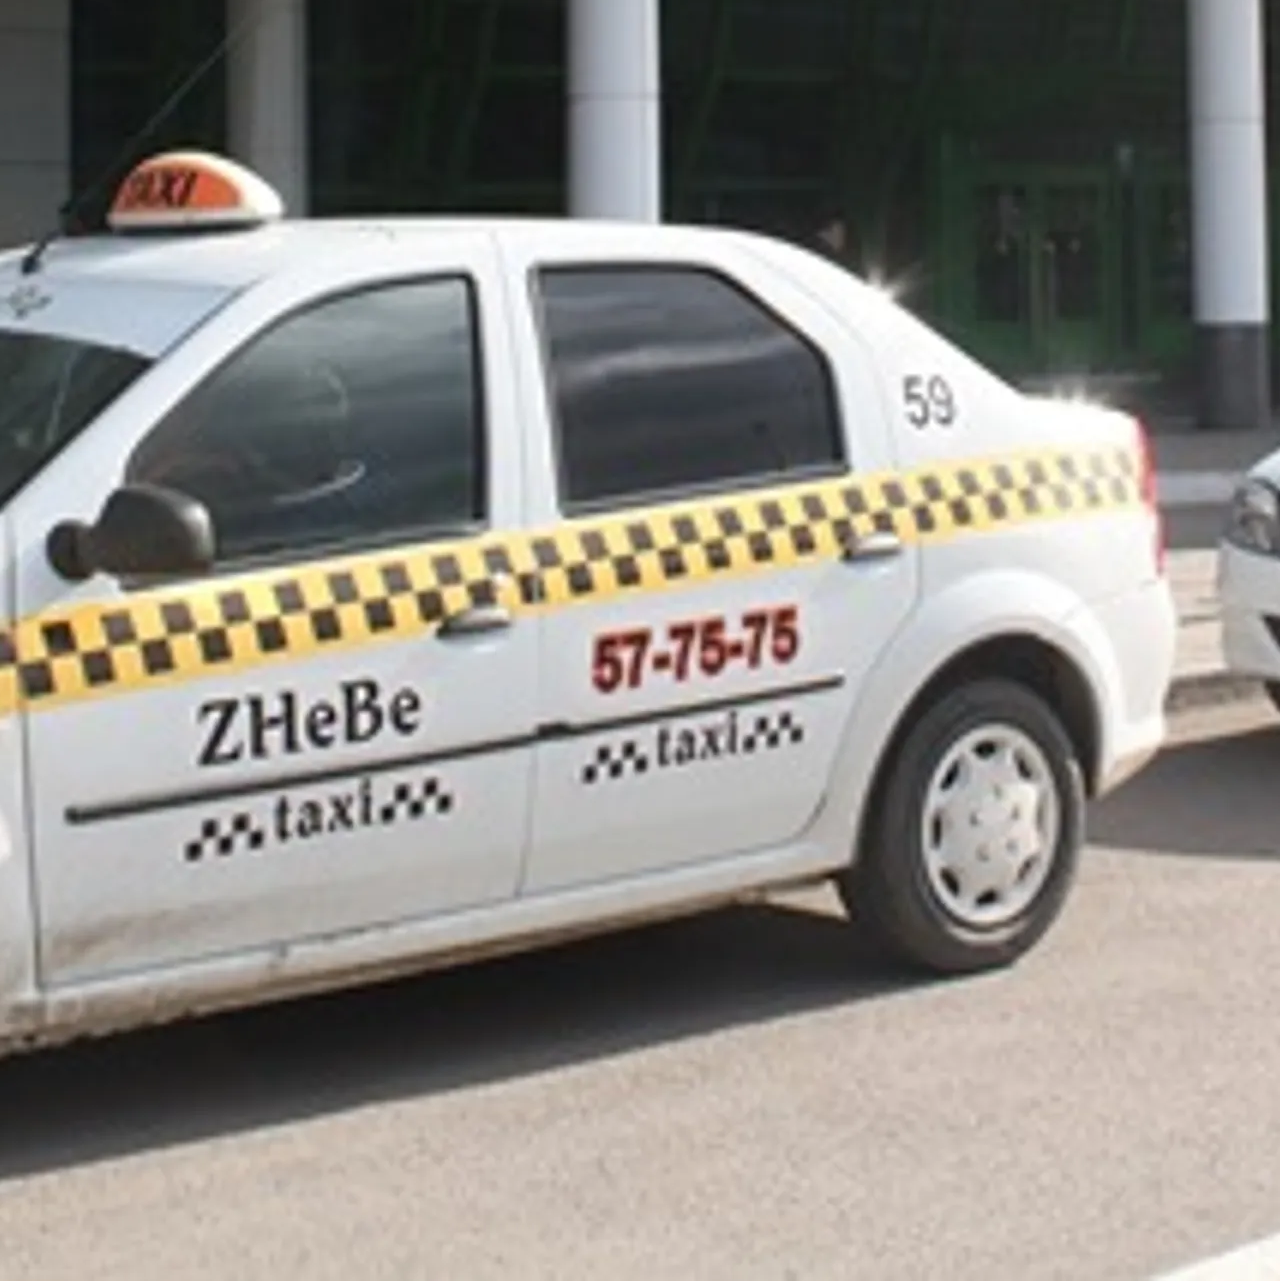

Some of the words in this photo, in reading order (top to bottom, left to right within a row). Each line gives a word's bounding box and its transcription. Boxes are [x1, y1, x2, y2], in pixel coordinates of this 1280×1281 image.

[903, 374, 955, 429] 59
[591, 605, 799, 694] 57-75-75
[197, 678, 422, 767] ZHeBe
[657, 710, 738, 766] taxi
[275, 776, 373, 843] taxi
